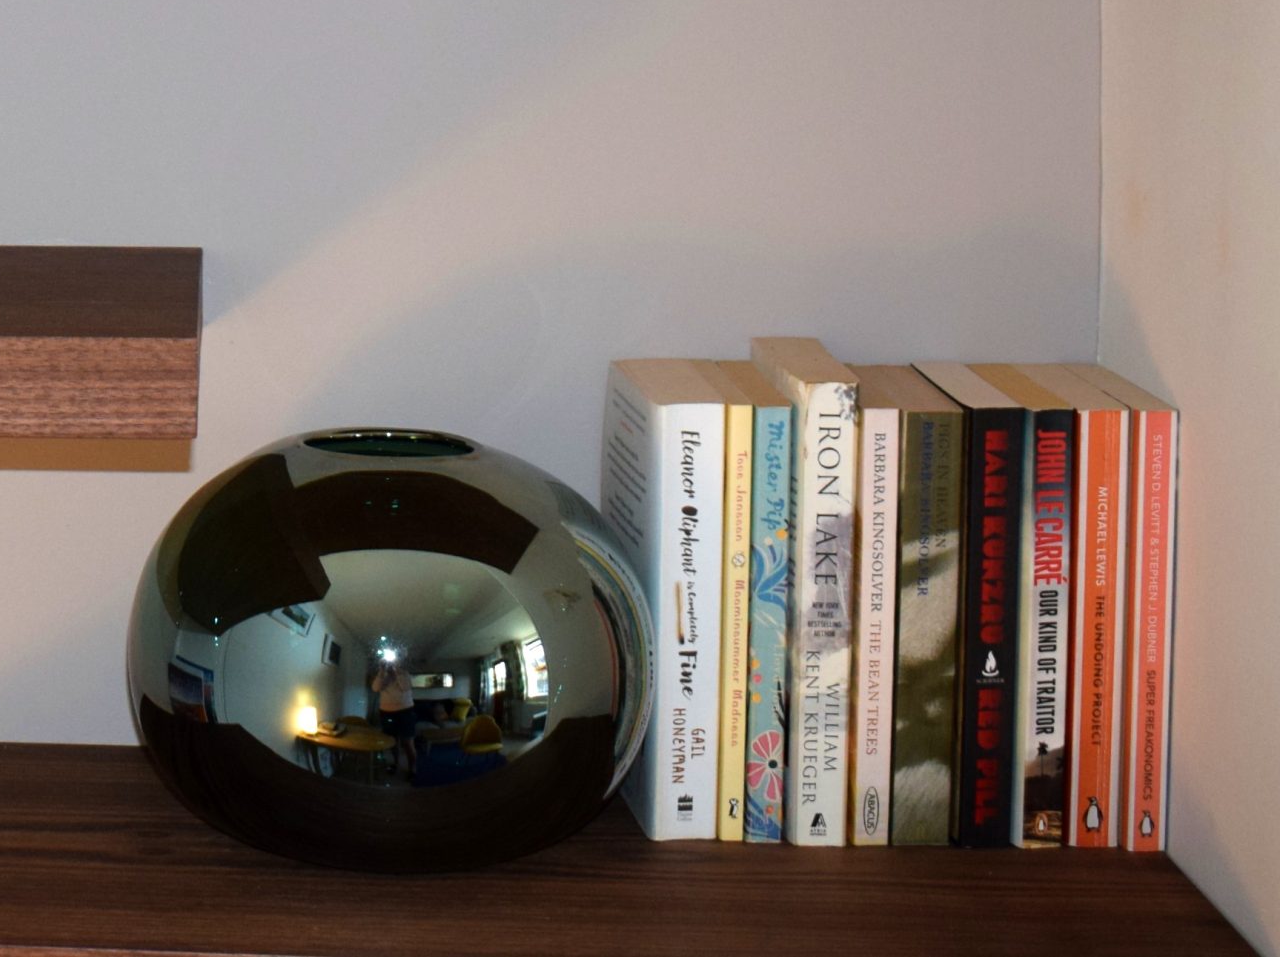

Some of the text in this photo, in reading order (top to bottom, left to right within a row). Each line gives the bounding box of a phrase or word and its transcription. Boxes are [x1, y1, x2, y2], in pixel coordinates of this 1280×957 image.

[679, 429, 701, 499] Eleanor
[736, 449, 747, 479] Tove
[759, 420, 786, 531] Mister Pip
[984, 430, 1009, 508] HARI
[1152, 434, 1163, 479] STEVEN
[735, 484, 746, 542] Jansson
[814, 410, 842, 586] IRON LAKE
[1150, 496, 1161, 535] LEVITT
[677, 504, 700, 576] Oliphant
[1149, 536, 1160, 545] &
[979, 515, 1007, 644] KUNZRU
[1033, 429, 1068, 735] JOHN LE CARRÉ OUR KIND OF TRAITOR
[1148, 547, 1160, 601] STEPHEN
[685, 591, 698, 644] Completely
[866, 432, 887, 829] BARBARA KINGSOLVER THE BEAN TREES ABACUS
[1091, 486, 1109, 746] MICHAEL LEWIS THE UNDOING PROJECT
[1146, 615, 1157, 662] DUBNER
[677, 649, 699, 701] Fine
[1145, 669, 1156, 706] SUPER
[671, 707, 687, 784] HONEYMAN
[690, 727, 705, 758] GAIL
[730, 689, 742, 747] Madness
[800, 648, 821, 805] KENT KRUEGER
[822, 681, 840, 772] WILLIAM
[977, 689, 1004, 750] RED
[1142, 708, 1155, 801] FREAKONOMICS
[974, 758, 1002, 824] PILL
